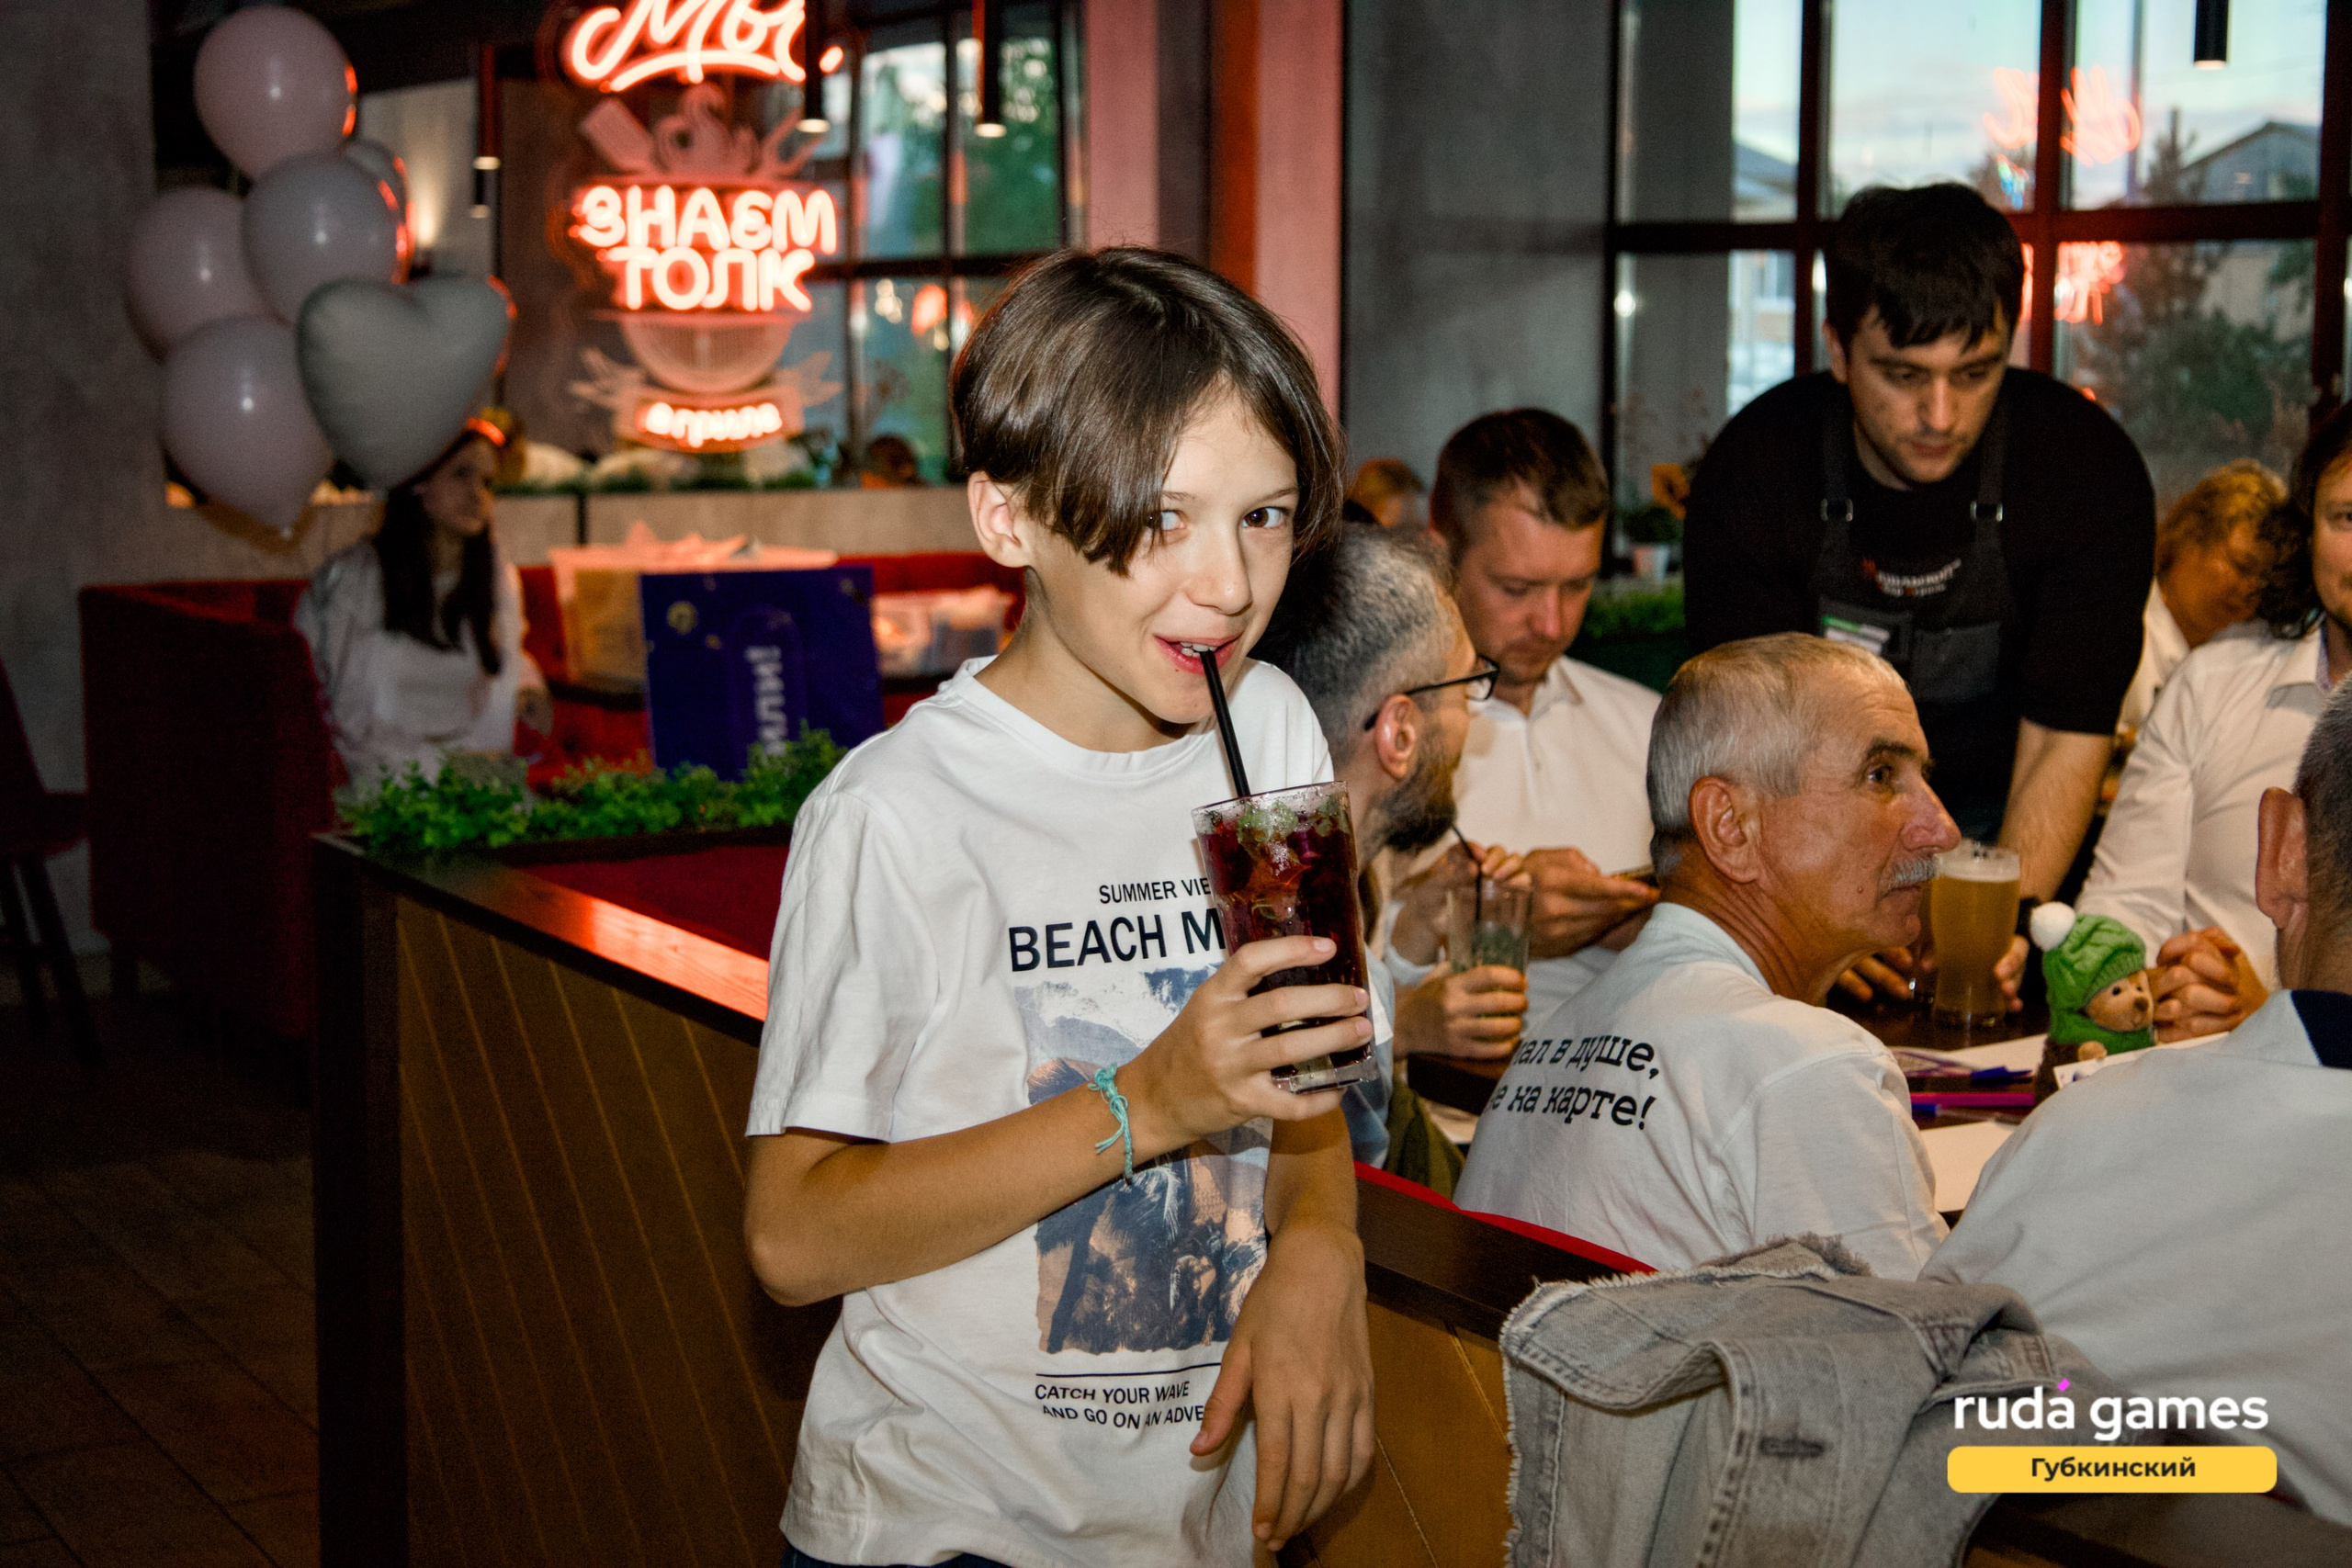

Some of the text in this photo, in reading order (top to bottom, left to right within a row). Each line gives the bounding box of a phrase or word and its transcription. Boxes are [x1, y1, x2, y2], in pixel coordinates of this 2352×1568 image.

[578, 185, 837, 255] ЗНАЕМ
[606, 245, 815, 311] ТОЛК
[1099, 880, 1178, 904] SUMMER
[1009, 914, 1167, 973] BEACH
[1549, 1039, 1573, 1065] в
[1566, 1034, 1659, 1080] душе,
[1486, 1085, 1657, 1131] е на карте!
[1035, 1381, 1191, 1404] CATCH YOUR WAVE
[1042, 1404, 1204, 1430] AND GO ON AN ADVE
